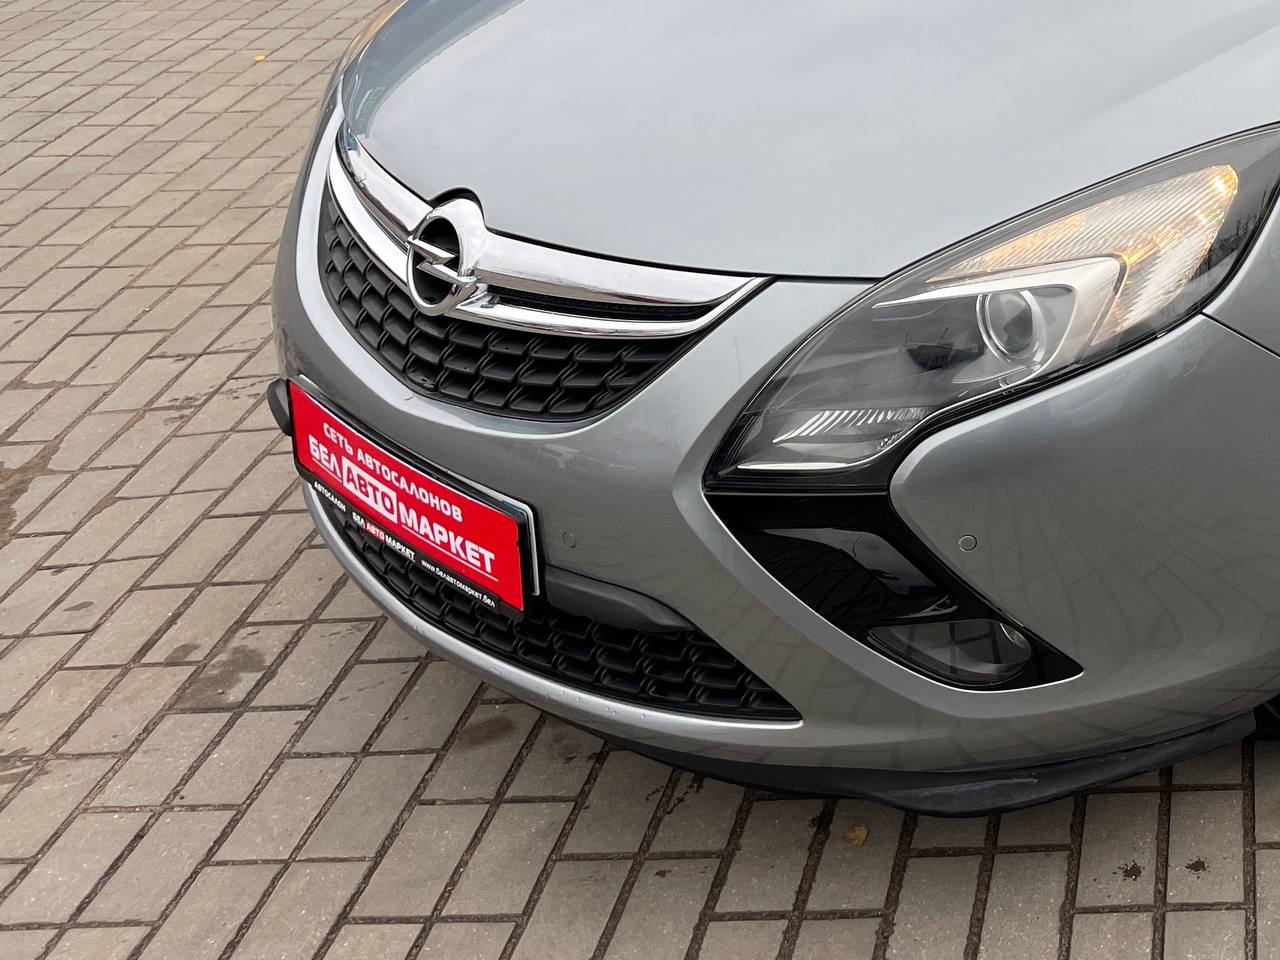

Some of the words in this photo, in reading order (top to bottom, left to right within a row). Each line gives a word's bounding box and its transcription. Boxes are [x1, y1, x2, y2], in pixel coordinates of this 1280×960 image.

[308, 435, 342, 478] БЕЛ
[343, 461, 395, 517] АВТО
[399, 501, 495, 573] МАРКЕТ
[313, 481, 347, 512] АВТОСАЛОН
[352, 511, 366, 529] БЕЛ
[366, 521, 385, 541] АВТО
[385, 534, 415, 560] МАРКЕТ
[323, 422, 354, 456] СЕТЬ
[357, 449, 463, 522] АВТОСАЛОНОВ
